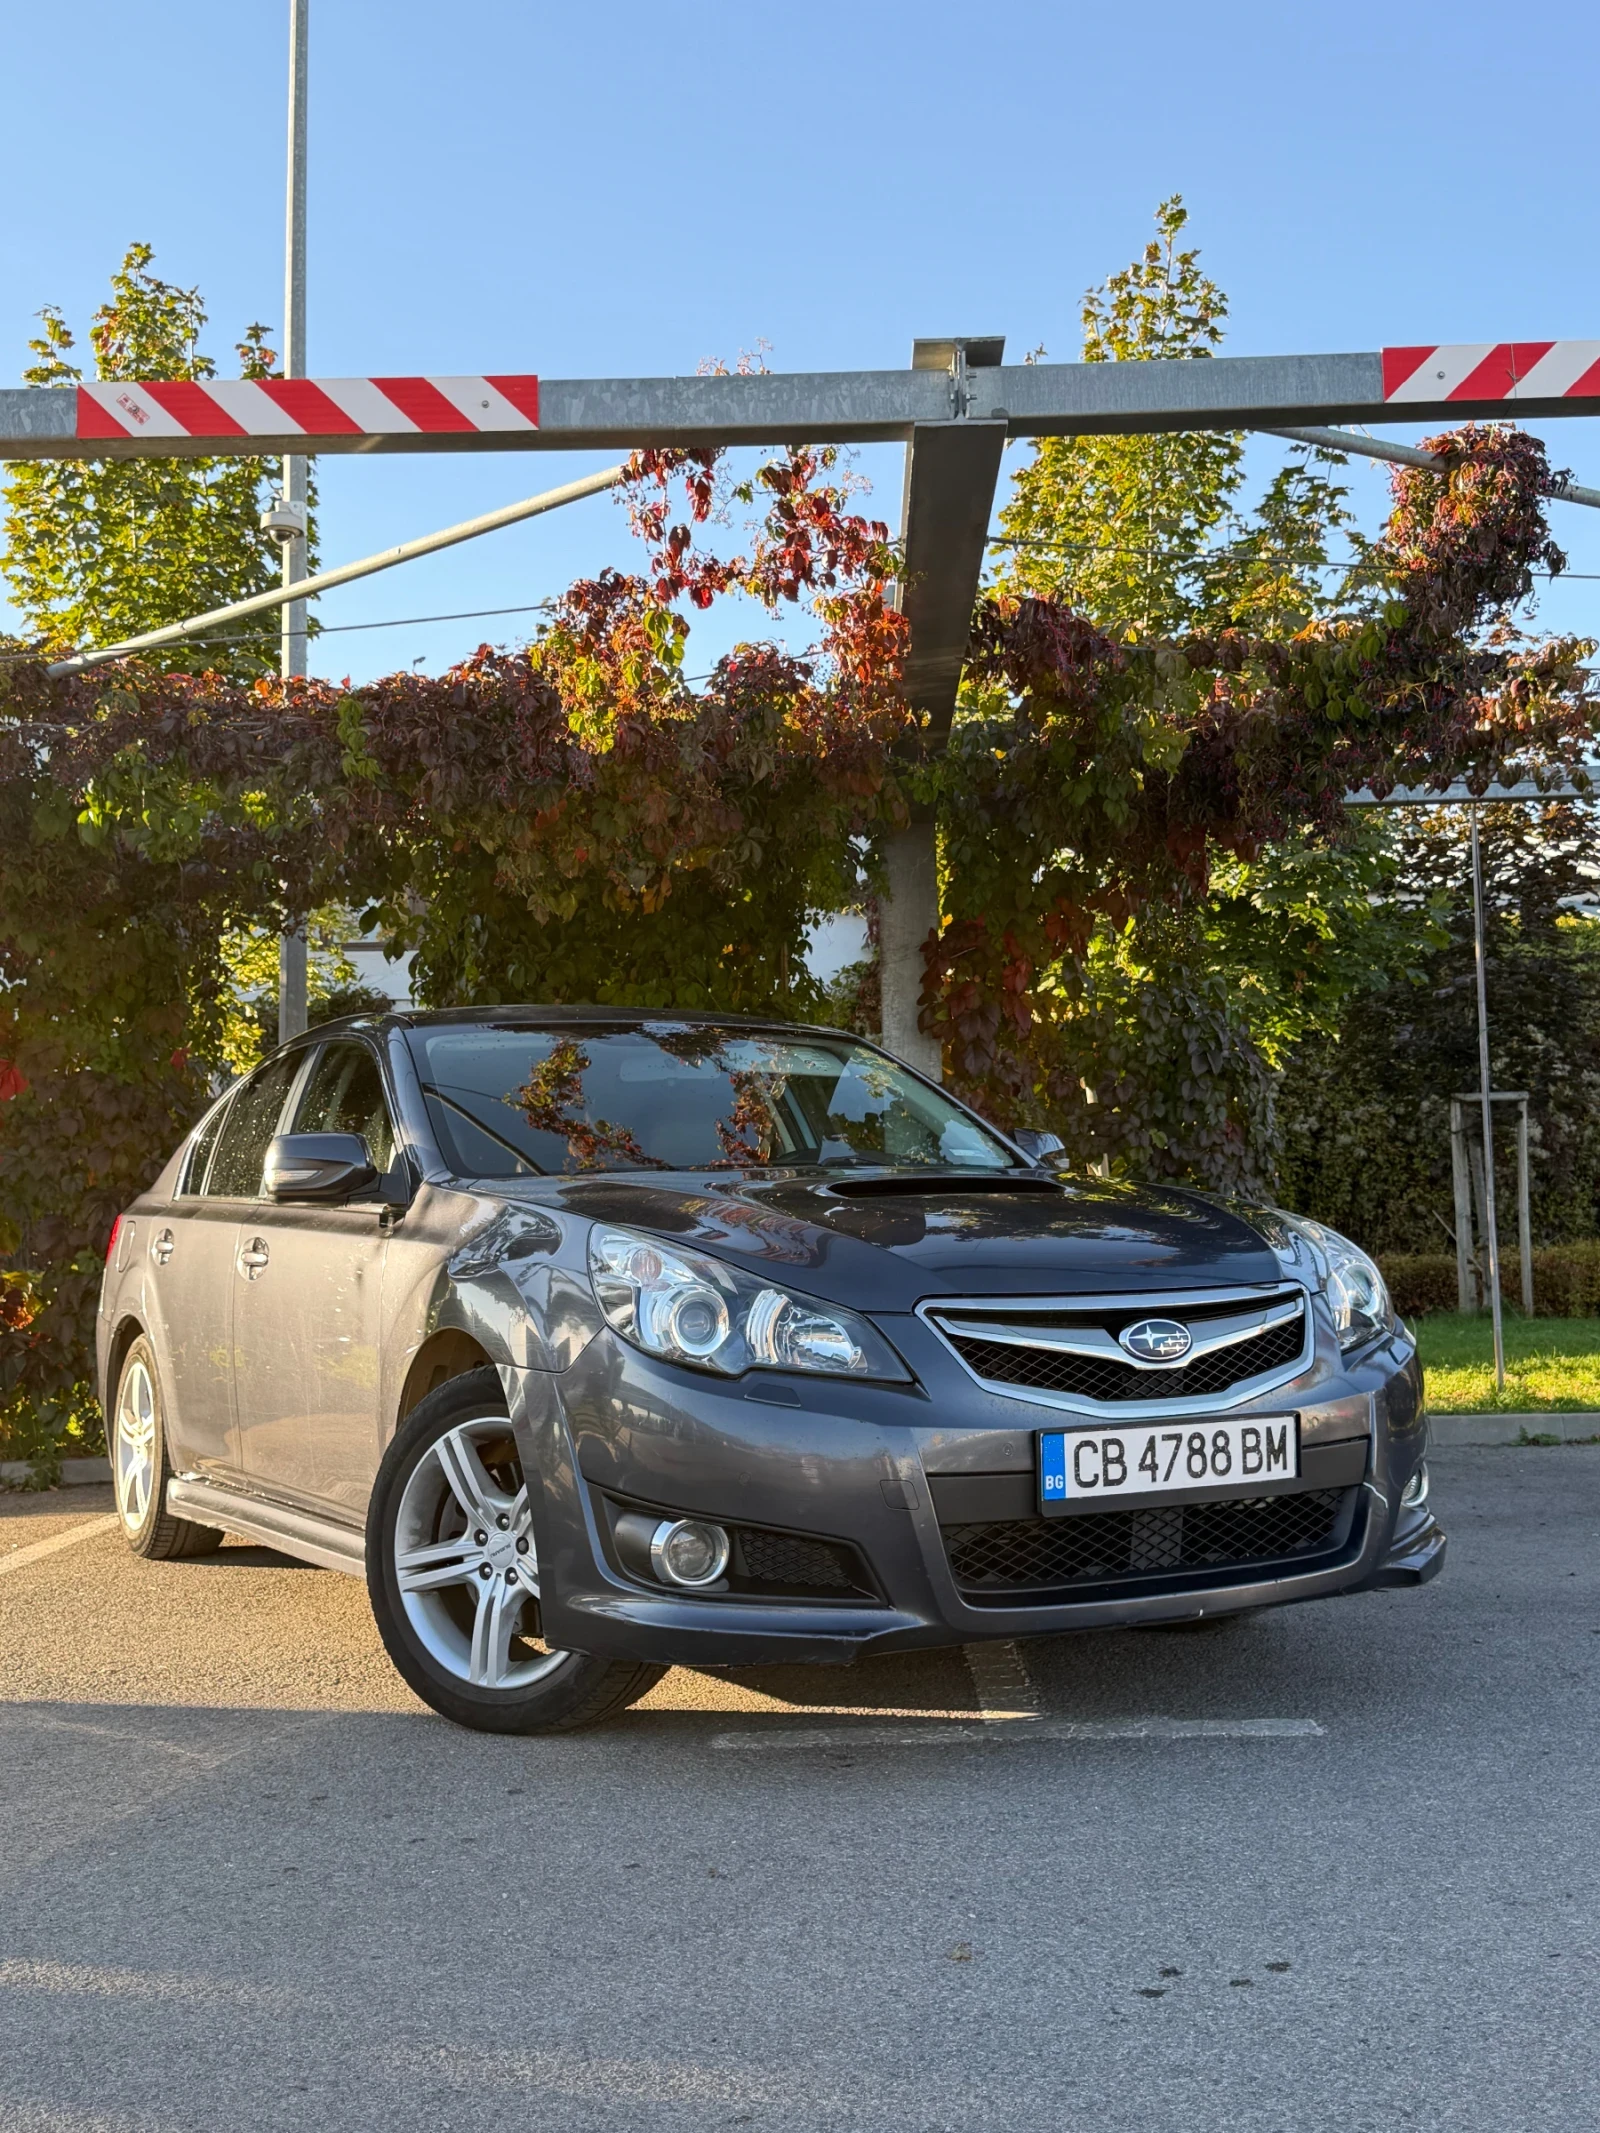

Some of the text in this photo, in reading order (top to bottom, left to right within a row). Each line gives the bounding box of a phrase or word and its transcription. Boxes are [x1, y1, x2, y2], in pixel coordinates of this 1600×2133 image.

[1073, 1424, 1288, 1489] CB 4788 BM
[1045, 1474, 1064, 1491] BG
[490, 1543, 511, 1558] SUBARU
